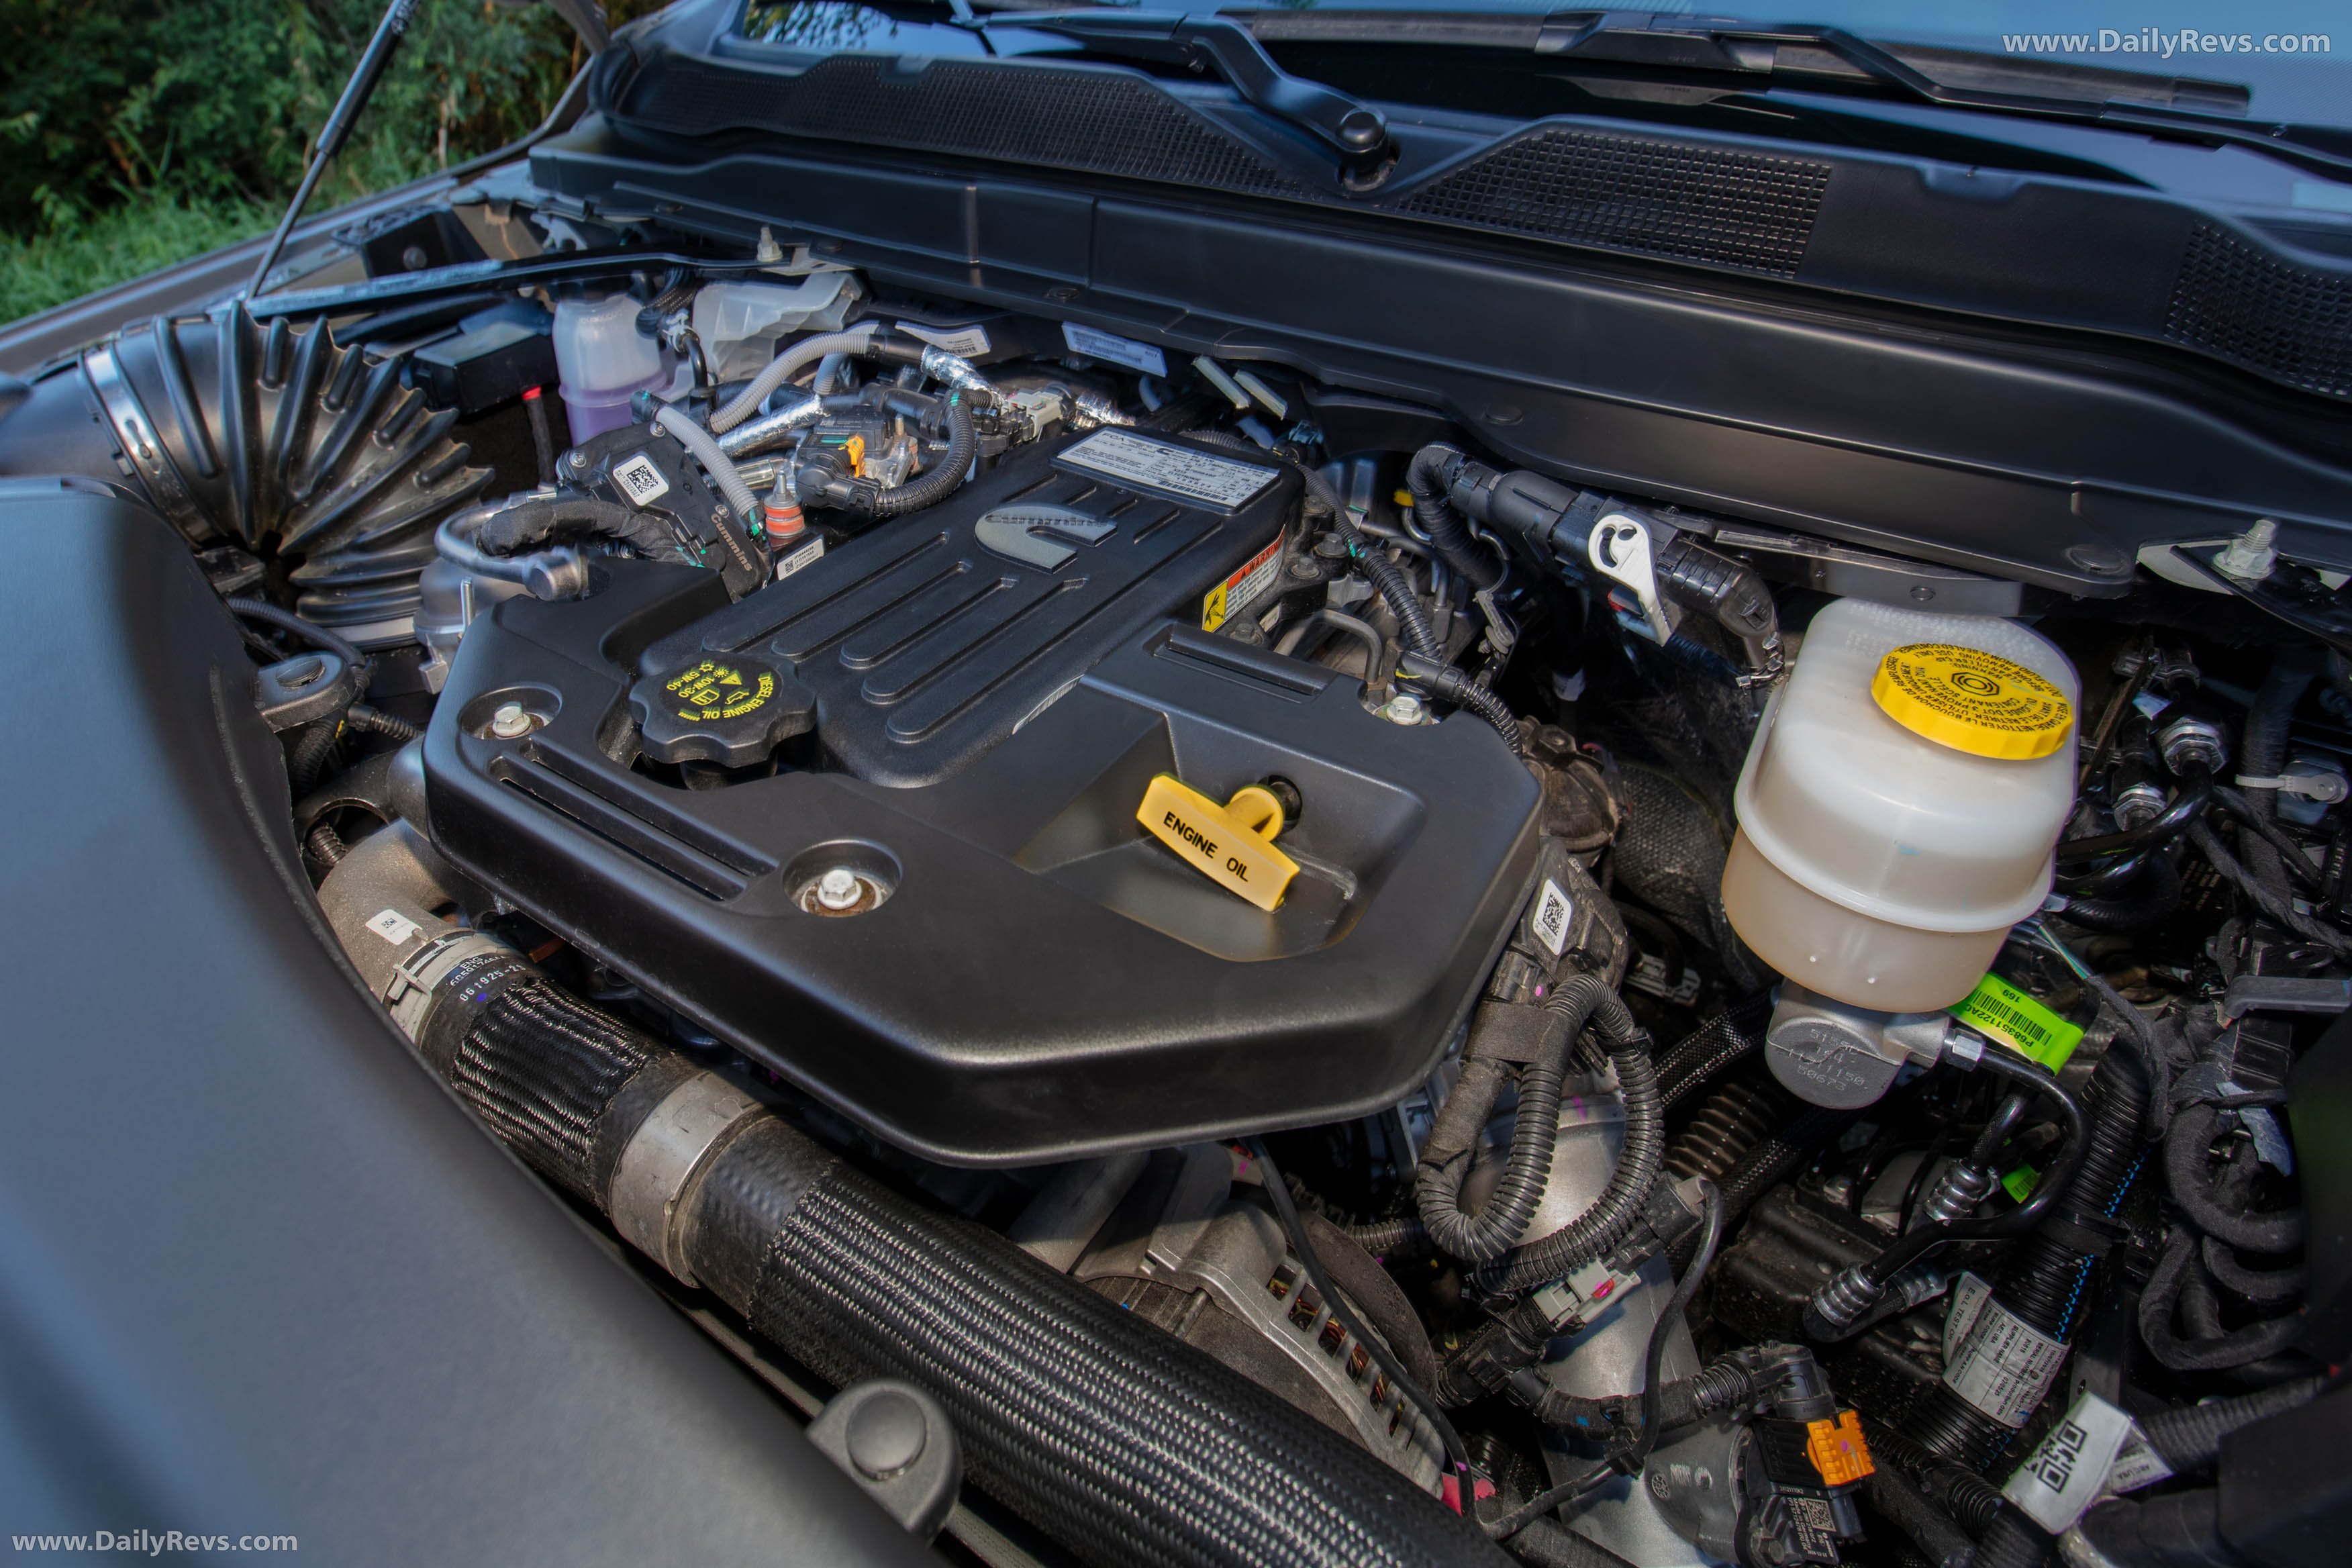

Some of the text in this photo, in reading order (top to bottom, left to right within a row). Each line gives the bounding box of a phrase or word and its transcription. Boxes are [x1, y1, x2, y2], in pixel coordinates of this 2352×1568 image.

[710, 512, 752, 572] Cummins
[1951, 658, 1988, 667] FILLER
[666, 671, 699, 690] 5W-40
[1990, 667, 2021, 683] CLEAN
[677, 676, 714, 697] 10W-30
[1902, 687, 1916, 696] DE
[1916, 678, 1969, 708] PROVENANT
[701, 676, 773, 719] DIESEL ENGINE OIL
[1925, 695, 1968, 716] UTILISER
[1961, 697, 2020, 708] CONTENANT
[1913, 695, 1961, 719] BOUCHON
[1965, 716, 1977, 724] LE
[1980, 721, 2035, 731] NETTOYER
[1163, 811, 1248, 883] ENGINE OIL
[460, 957, 483, 969] ENG
[2003, 988, 2021, 1003] 169
[1965, 1003, 2035, 1048] P68351122AC
[1955, 1310, 1965, 1328] TEST
